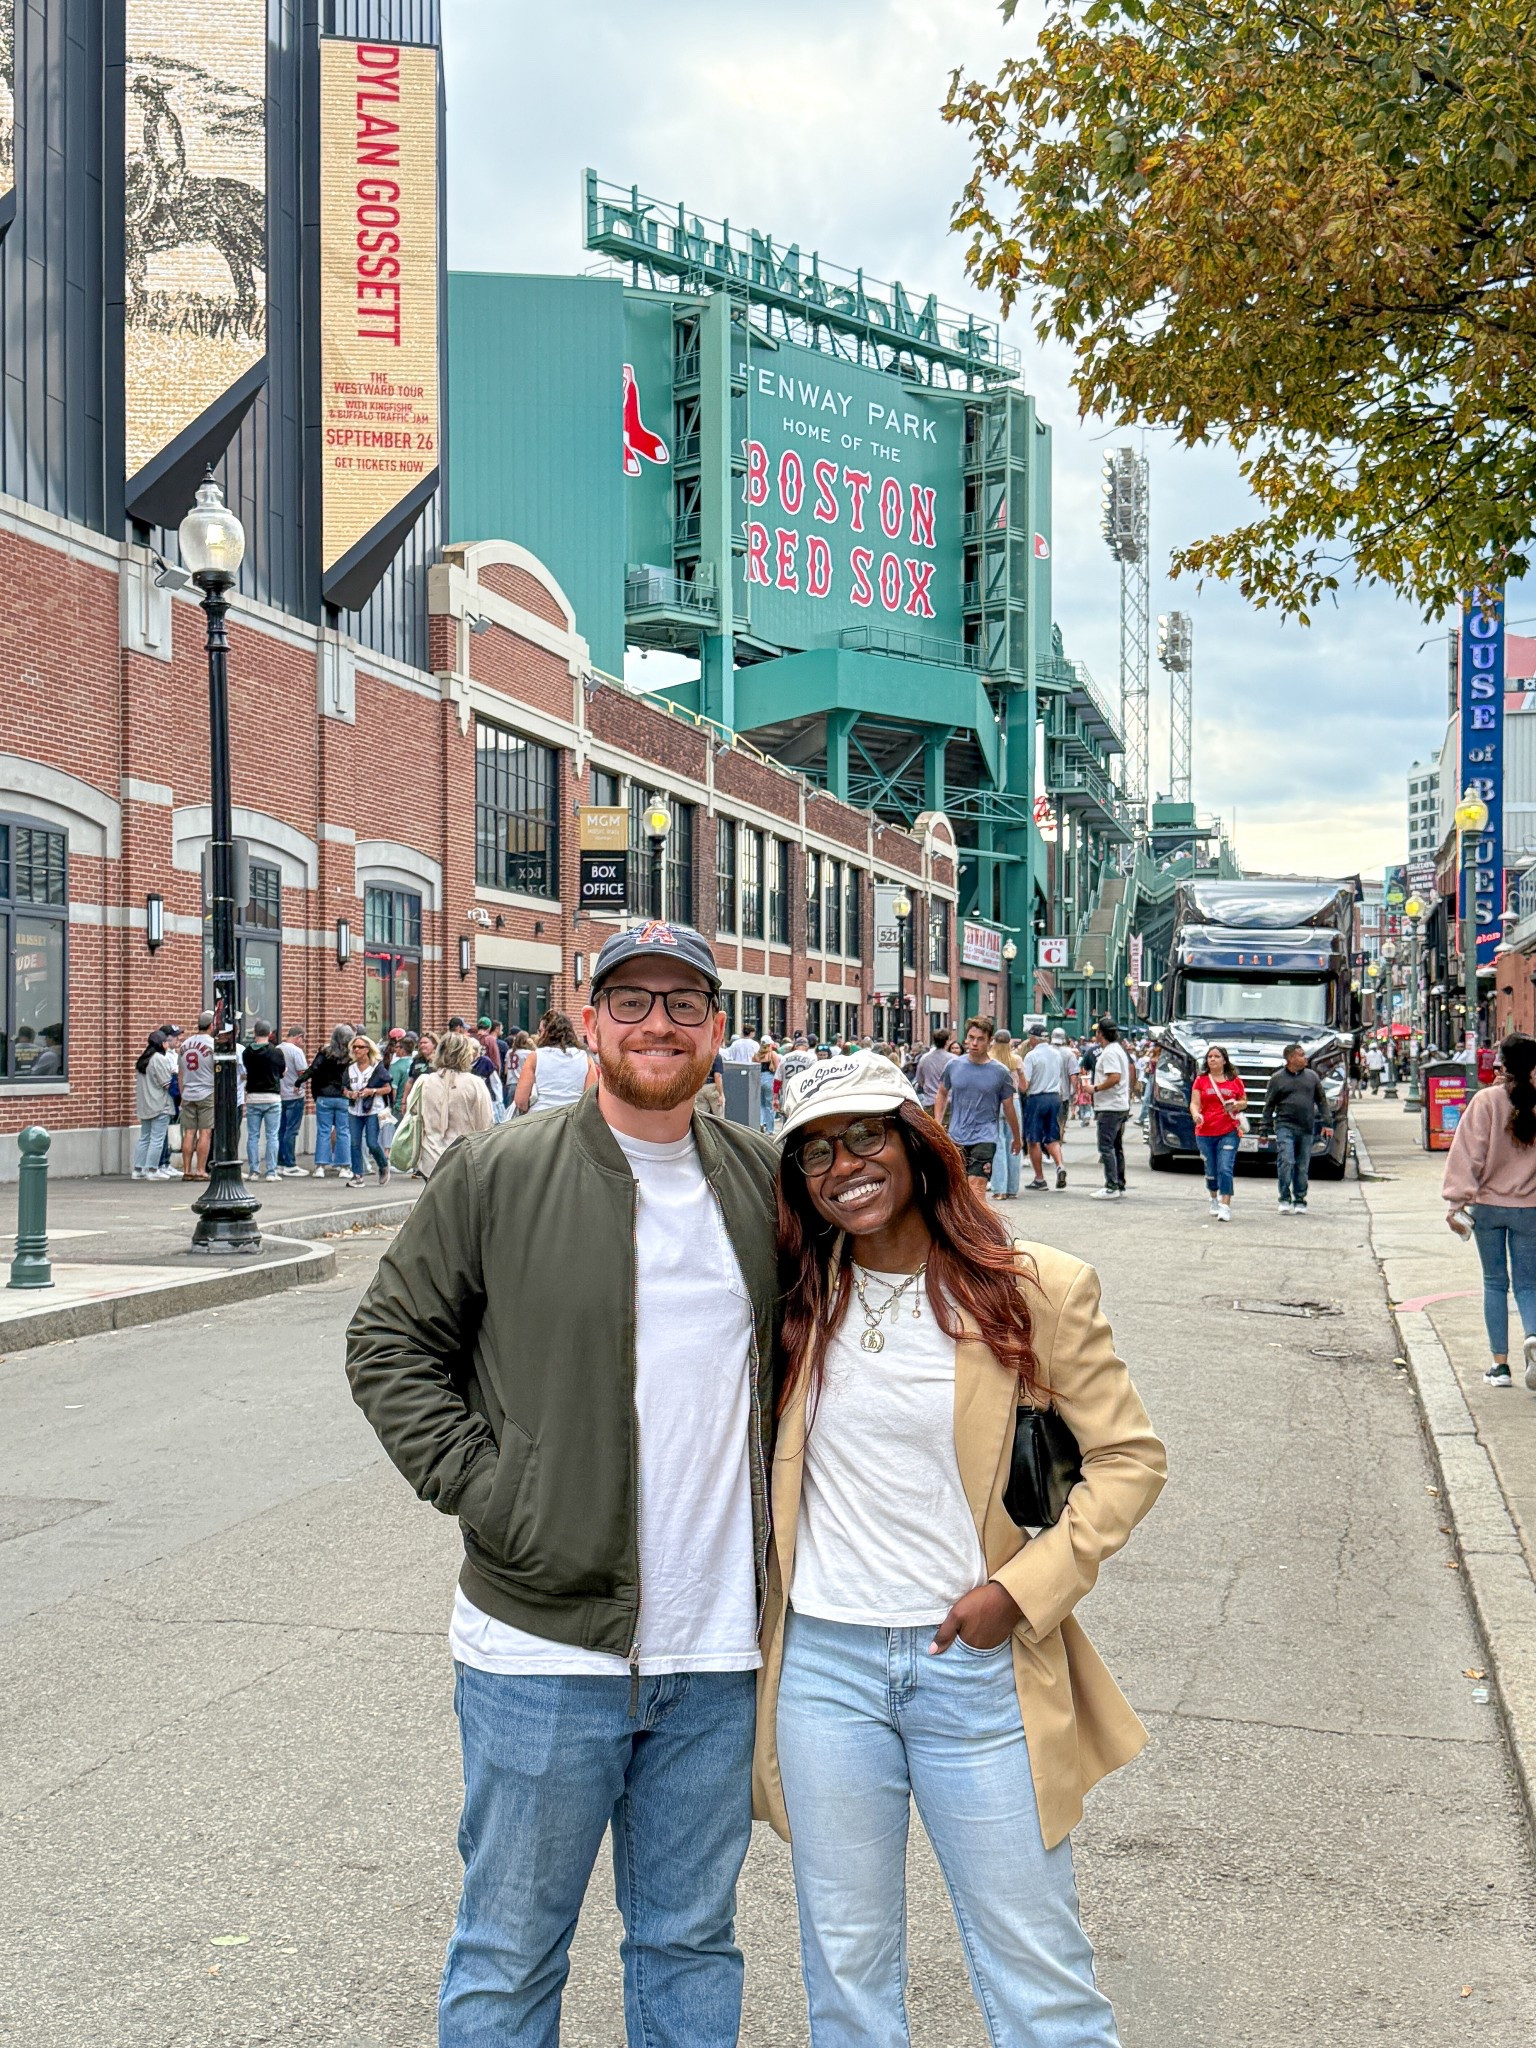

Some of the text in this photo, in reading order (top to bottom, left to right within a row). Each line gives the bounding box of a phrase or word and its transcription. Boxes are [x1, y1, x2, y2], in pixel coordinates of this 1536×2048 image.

[357, 44, 400, 346] DYLAN GOSSETT
[370, 372, 388, 383] THE
[333, 382, 423, 398] WESTWARD TOUR
[345, 400, 367, 410] WITH
[338, 410, 374, 420] BUFFALO
[376, 412, 409, 422] TRAFFIC
[412, 414, 429, 424] JAM
[868, 402, 937, 444] PARK
[326, 429, 433, 450] SEPTEMBER 26
[783, 417, 900, 462] HOME OF THE
[335, 457, 424, 472] GET TICKETS NOW
[741, 439, 936, 548] BOSTON
[743, 521, 936, 619] RED SOX
[1468, 744, 1495, 762] of
[587, 815, 620, 827] MGM
[1473, 777, 1495, 924] BUES
[591, 866, 616, 878] BOX
[583, 883, 624, 896] OFFICE
[881, 931, 897, 941] 521
[1476, 932, 1501, 944] ston
[1044, 948, 1061, 963] C
[186, 1052, 199, 1071] 9
